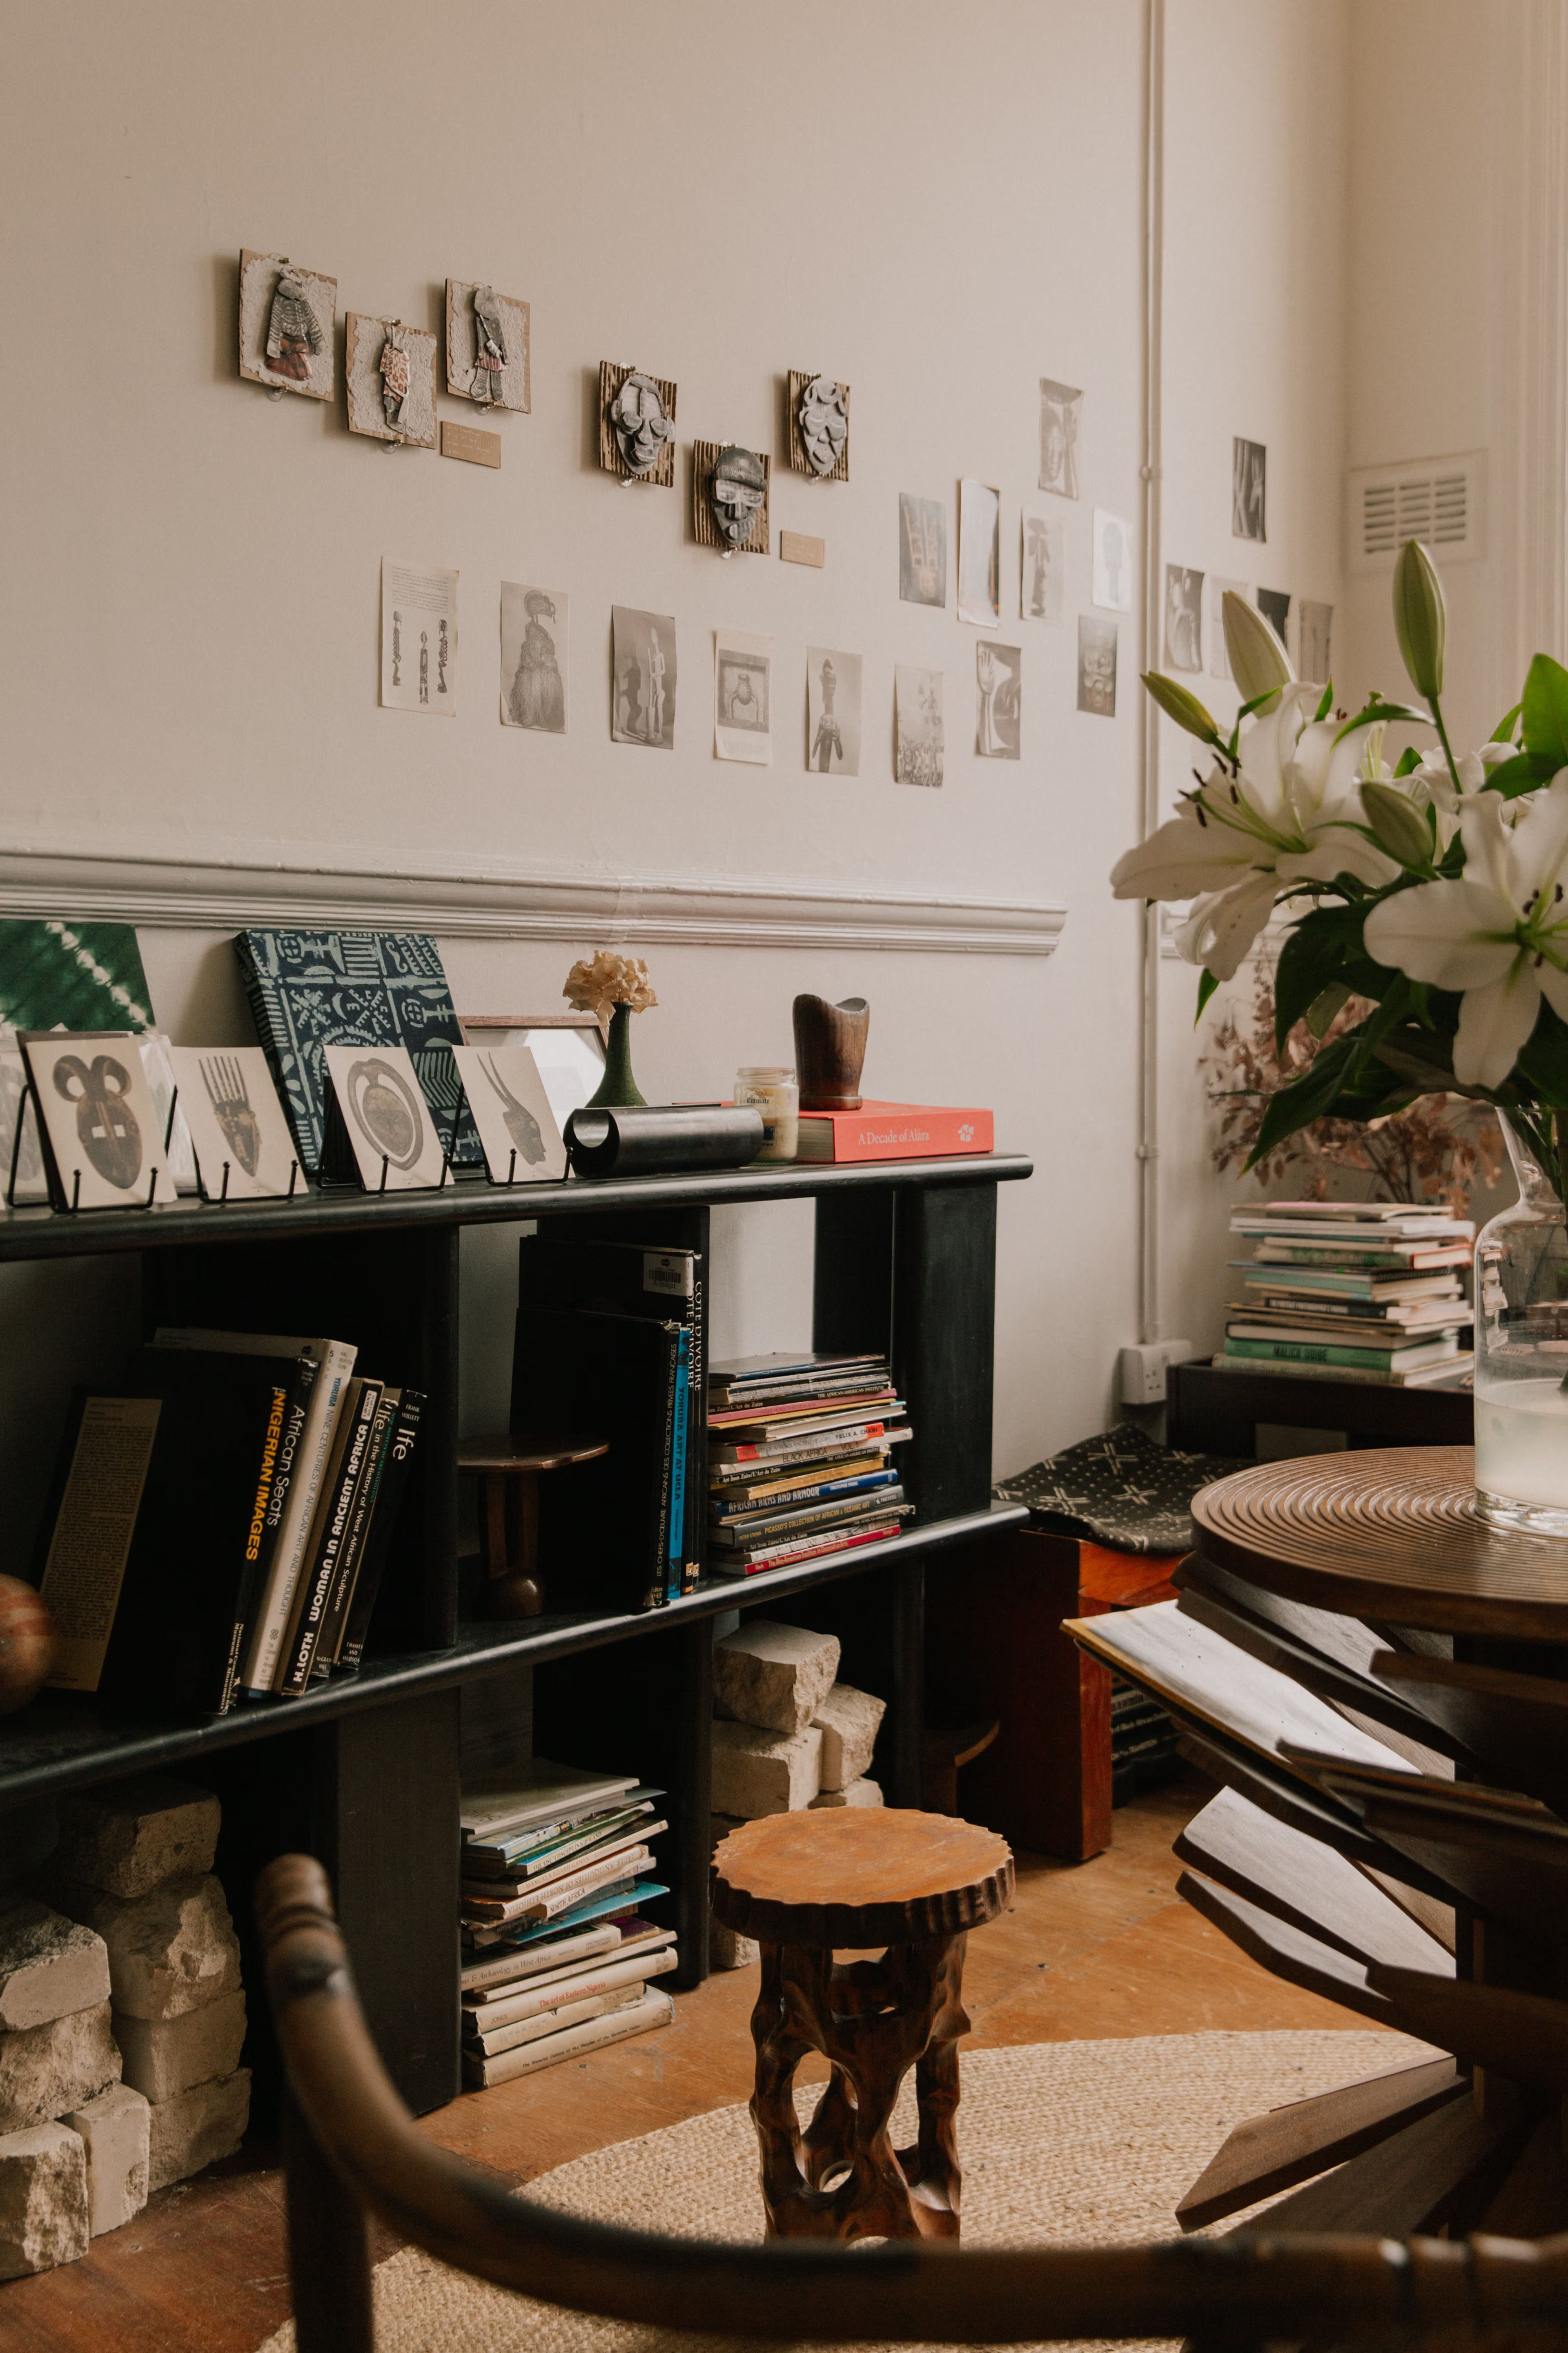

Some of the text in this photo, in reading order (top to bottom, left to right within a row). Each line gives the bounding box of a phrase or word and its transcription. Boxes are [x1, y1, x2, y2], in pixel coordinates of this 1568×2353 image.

[858, 1133, 866, 1144] A
[866, 1130, 898, 1144] Decade
[899, 1128, 908, 1142] of
[826, 1388, 864, 1398] AFRICAN-AMERICAN
[402, 1412, 420, 1422] WILLETT
[405, 1404, 421, 1413] FRANK
[392, 1428, 416, 1460] Ife
[664, 1410, 673, 1455] COLLECTIONS
[347, 1424, 368, 1475] AFRICA
[782, 1447, 827, 1463] BLACK AFRICA
[841, 1442, 854, 1451] VOL
[245, 1392, 287, 1561] NIGERIAN IMAGES
[267, 1404, 305, 1526] African Seats
[675, 1459, 682, 1470] AT
[741, 1470, 764, 1479] Zaire/L'Art
[279, 1377, 341, 1616] YORUBA NINE CENTURIES OF AFRICAN ART AND THOUGHT
[830, 1482, 848, 1490] CHRISTOPHER
[880, 1494, 897, 1503] PRESTEL
[332, 1476, 354, 1536] ANCIENT
[334, 1409, 390, 1612] Ife in the History of West African Sculpture
[728, 1487, 820, 1513] AFRICAN ARMS AND ARMOUR
[764, 1522, 788, 1534] PICASSO'S
[788, 1515, 814, 1528] COLLECTION
[822, 1509, 840, 1519] AFRICAN
[844, 1503, 862, 1514] OCEANIC
[327, 1540, 339, 1555] IN
[775, 1553, 802, 1566] Afro-American
[802, 1550, 816, 1559] Tradition
[309, 1558, 333, 1622] WOMAN
[229, 1622, 240, 1656] Museums
[235, 1623, 244, 1655] National
[346, 1642, 363, 1650] THAMES
[293, 1632, 314, 1683] H.LOTH
[343, 1655, 360, 1663] HUDSON
[220, 1667, 232, 1710] Monuments
[227, 1655, 238, 1700] Commission
[554, 1846, 574, 1860] CONCEPT
[525, 1857, 589, 1889] MANCALA BOARD GAMES
[575, 1863, 612, 1883] ANTIQUITIES
[507, 1895, 539, 1915] ETHIOPIA
[541, 1886, 566, 1902] NORTH
[550, 1899, 566, 1914] NORTH
[567, 1887, 585, 1905] AFRICA
[479, 1966, 512, 1981] Archaeology
[520, 1957, 535, 1968] West
[535, 1954, 551, 1965] Africa
[539, 1981, 606, 2007] The art of Eastern Nigeria
[490, 2014, 508, 2024] JONES
[531, 2056, 548, 2065] Material
[550, 2051, 565, 2059] Culture
[581, 2041, 595, 2049] Peoples
